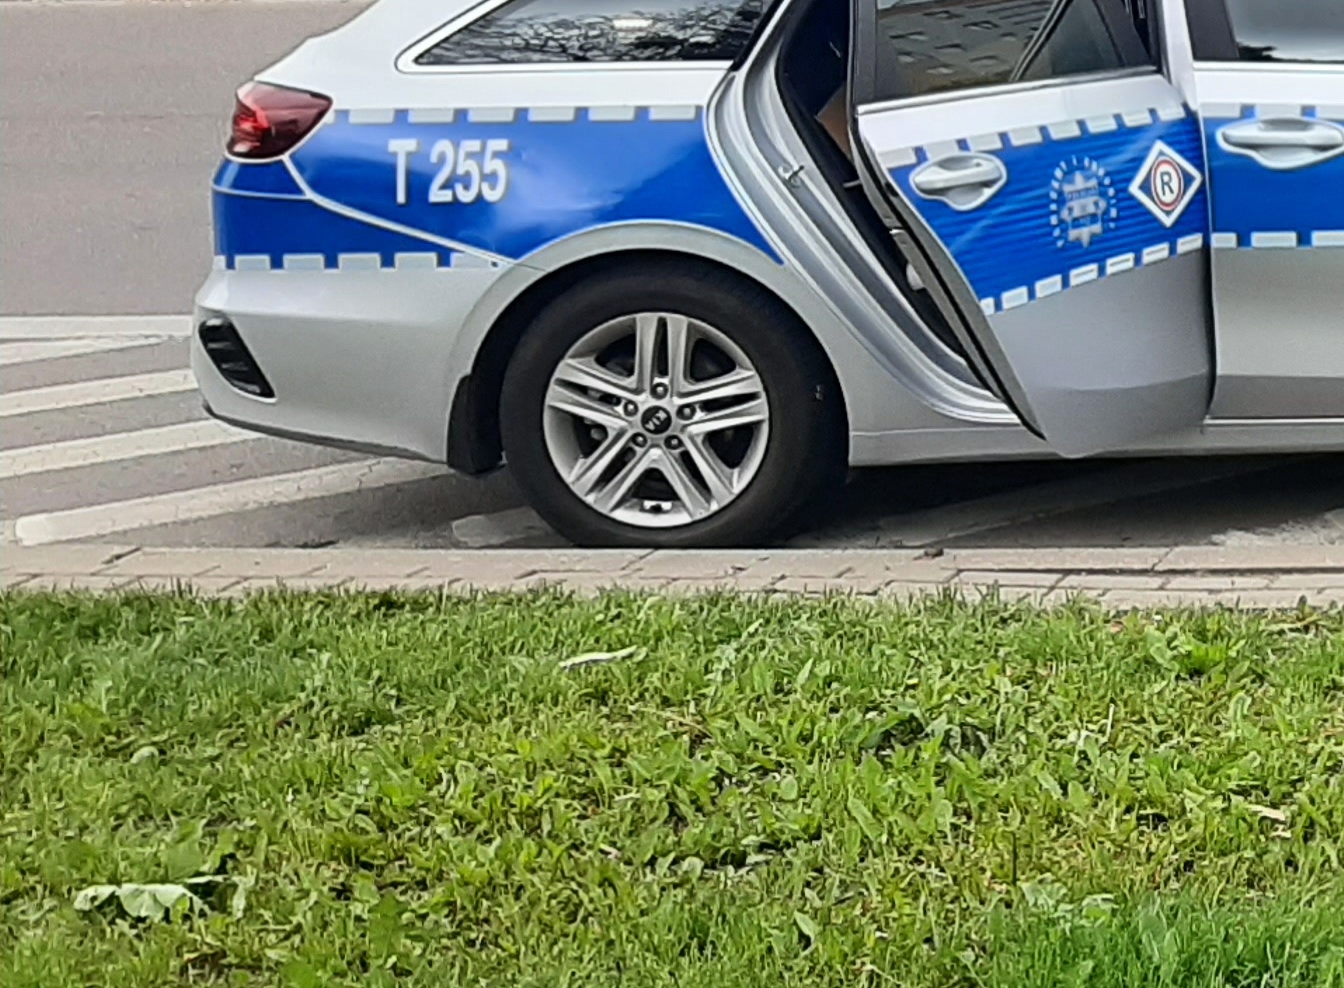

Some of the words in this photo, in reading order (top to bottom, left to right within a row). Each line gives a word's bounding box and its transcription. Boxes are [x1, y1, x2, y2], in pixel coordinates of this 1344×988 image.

[387, 137, 419, 205] T
[428, 137, 511, 205] 255
[1159, 170, 1175, 197] R
